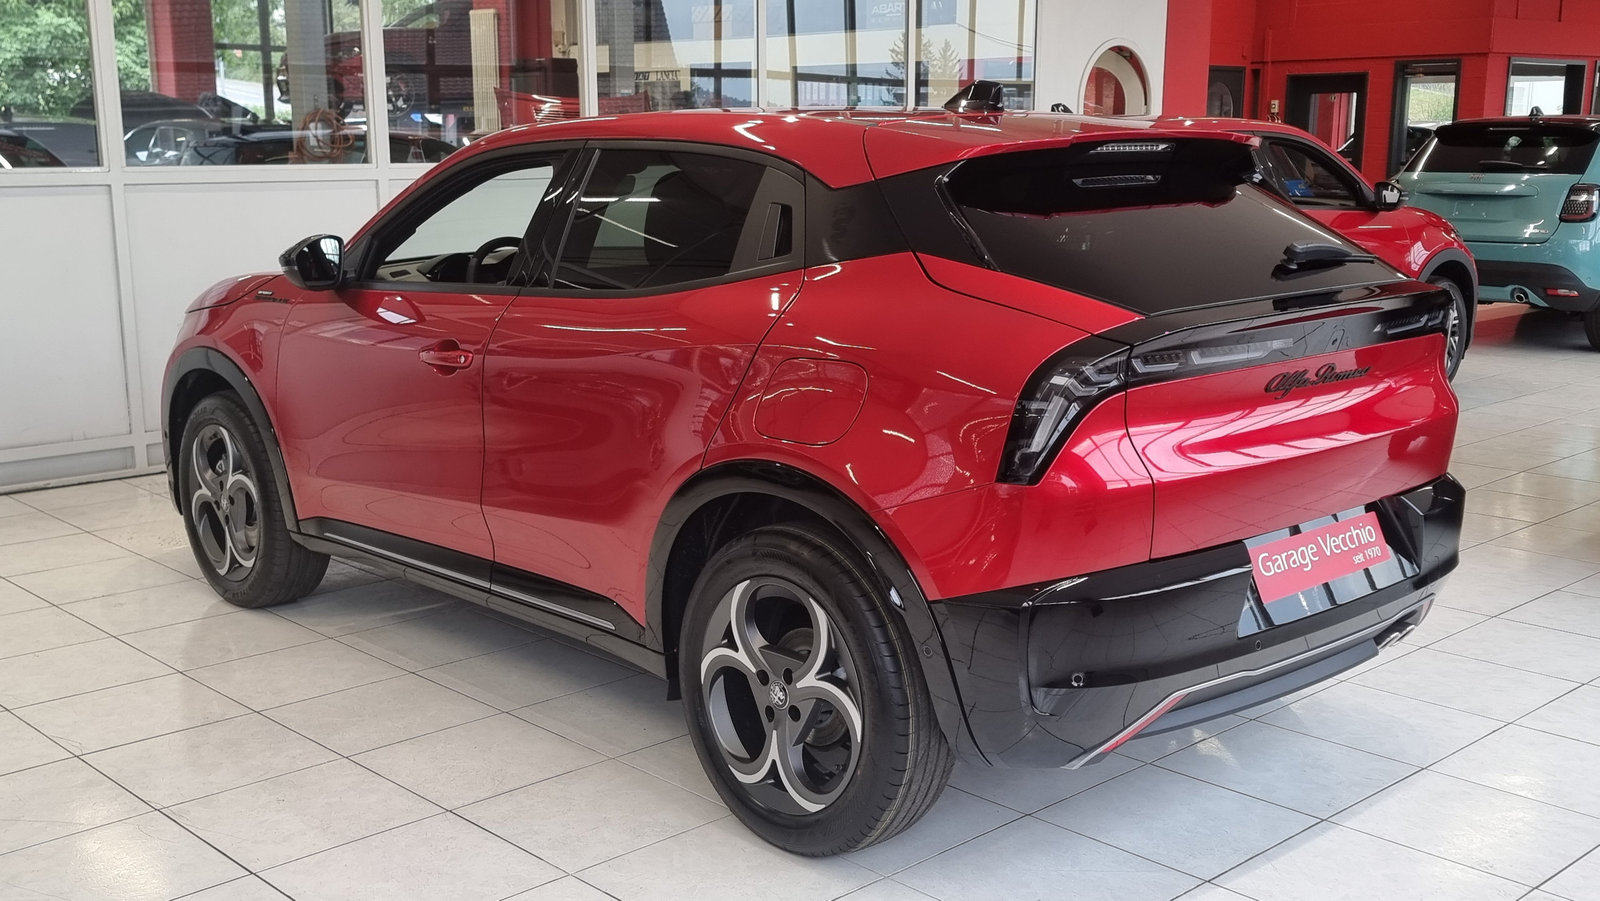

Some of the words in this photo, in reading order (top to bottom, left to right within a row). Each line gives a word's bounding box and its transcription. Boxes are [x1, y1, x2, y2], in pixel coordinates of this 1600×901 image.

[1264, 371, 1311, 400] Alfa
[1310, 362, 1372, 387] Romeo
[1258, 543, 1319, 577] Garage
[1317, 522, 1376, 556] Vecchio
[1352, 551, 1366, 565] seit
[1364, 546, 1382, 560] 1970
